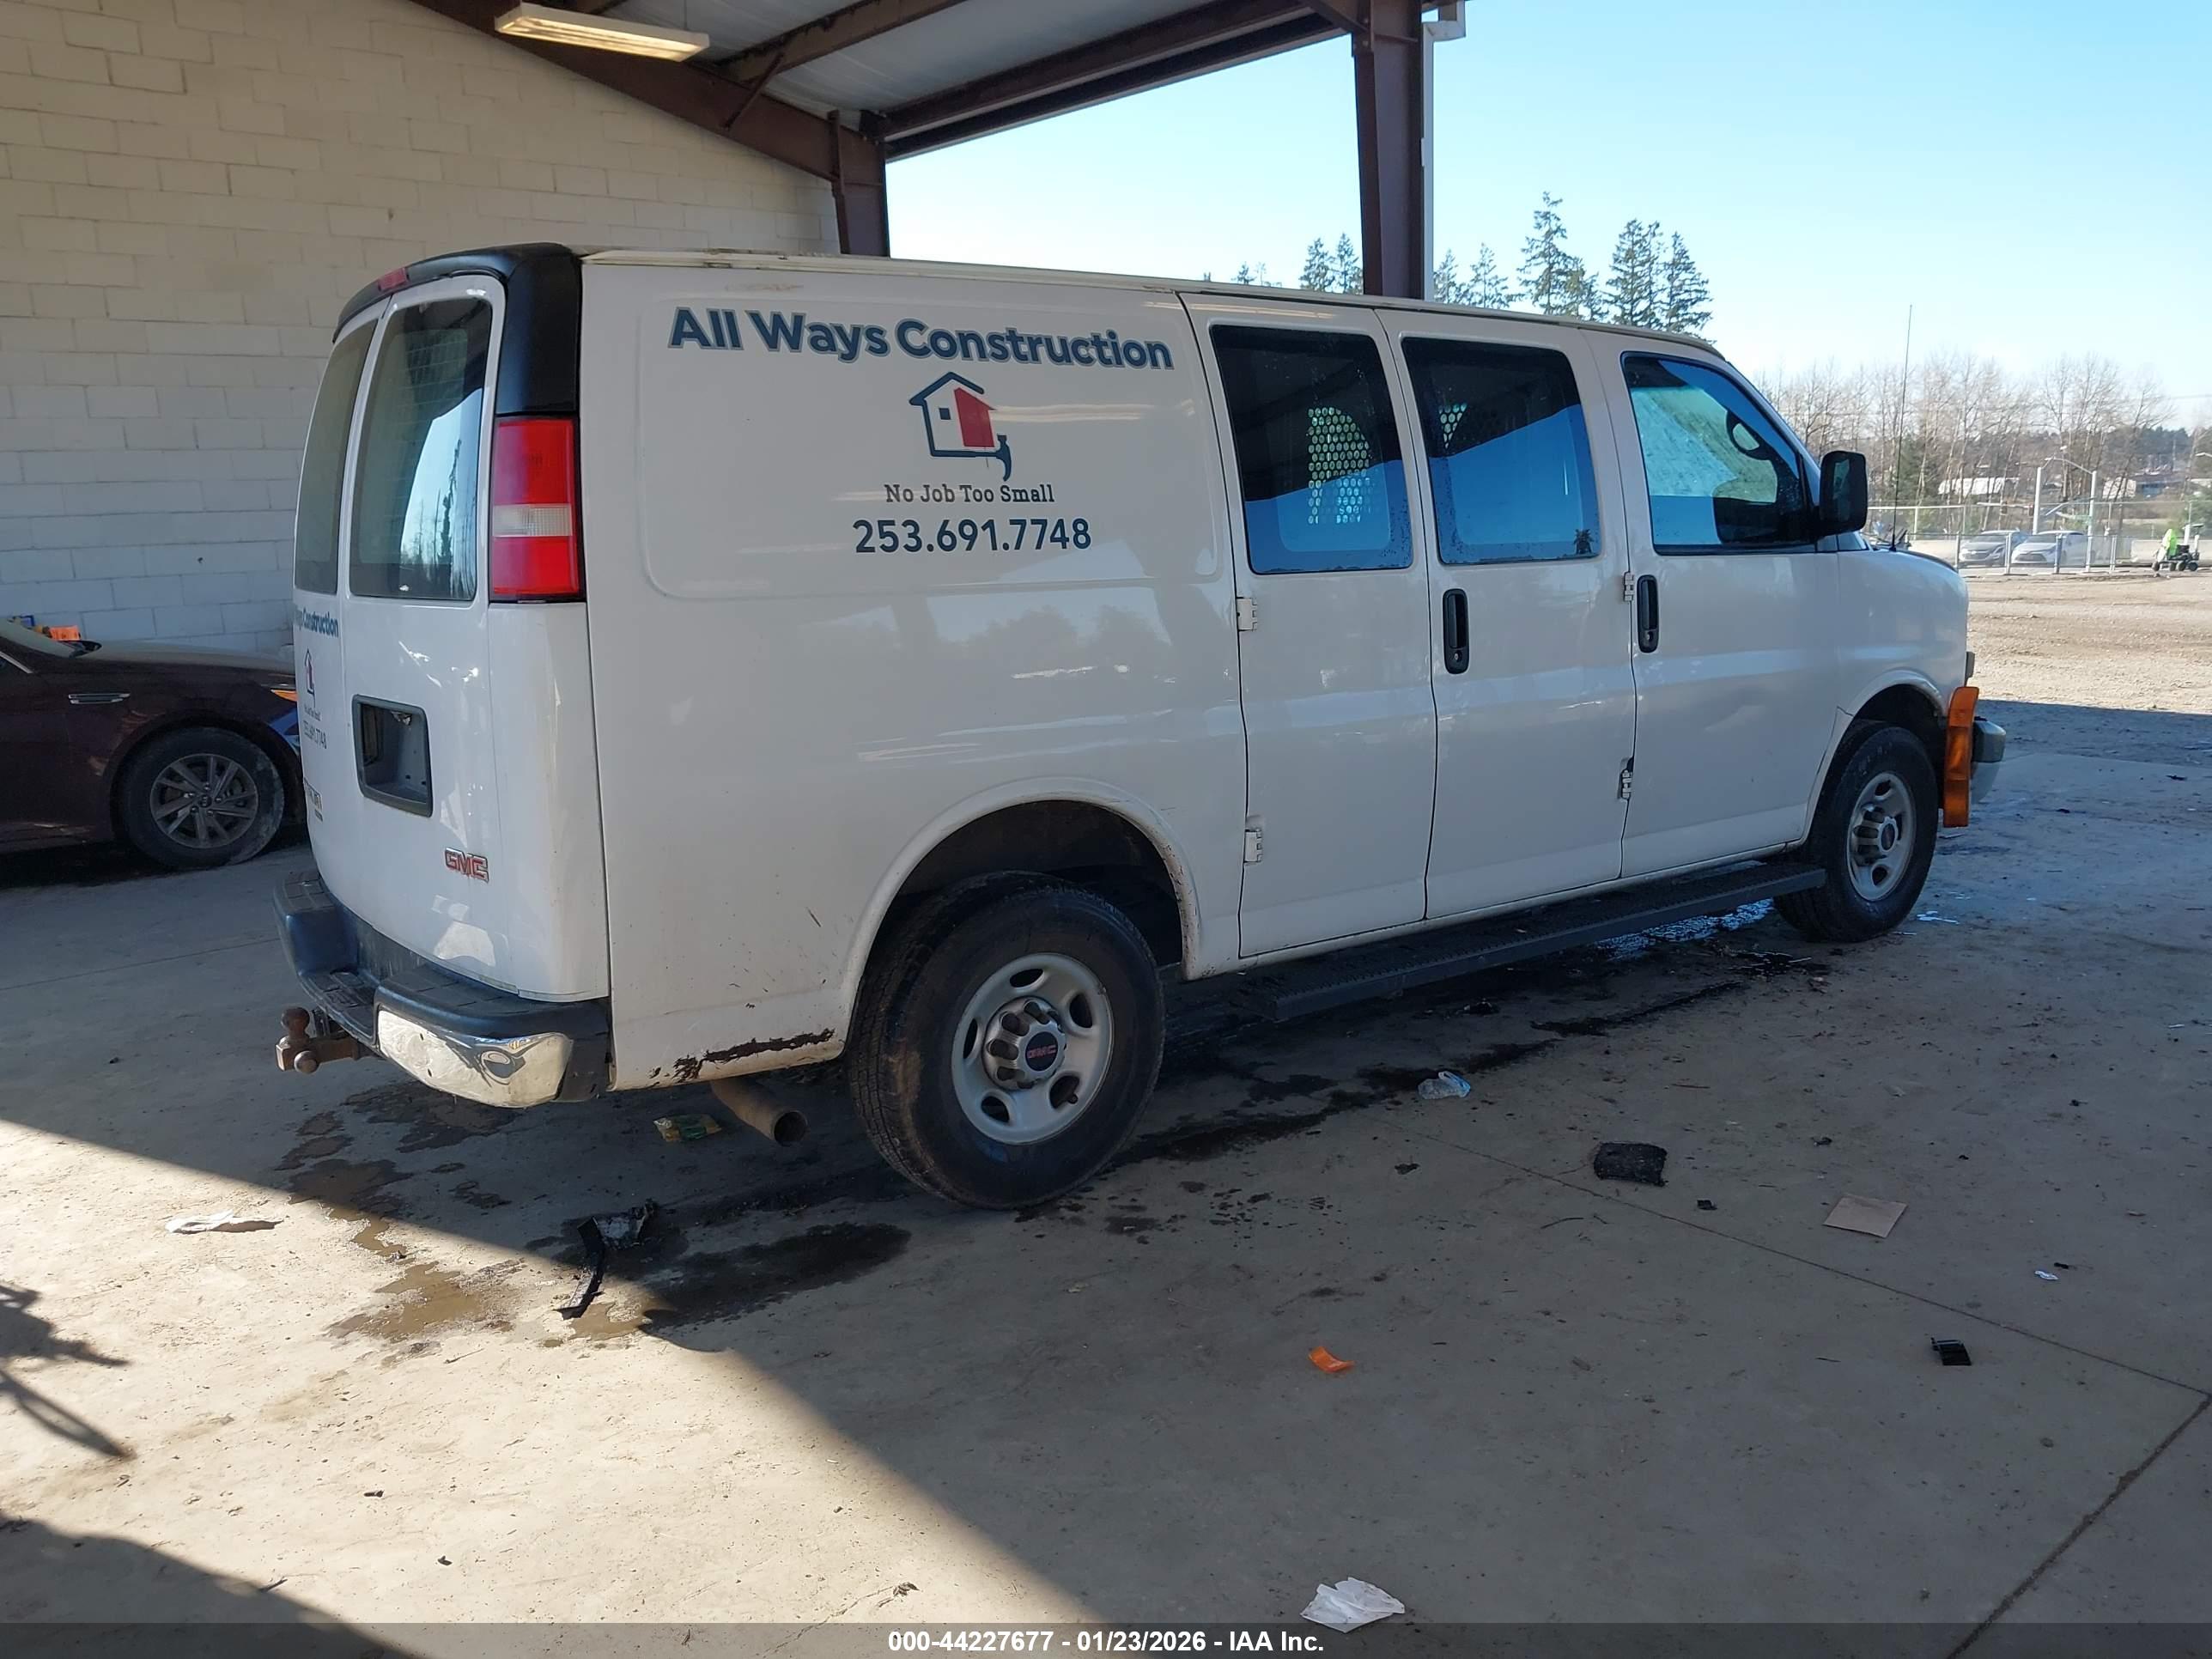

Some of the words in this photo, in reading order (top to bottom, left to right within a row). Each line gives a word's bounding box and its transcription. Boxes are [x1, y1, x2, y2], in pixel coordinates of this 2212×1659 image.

[667, 307, 744, 350] All
[744, 310, 891, 363] Ways
[895, 319, 1174, 370] Construction
[884, 483, 914, 503] No
[920, 483, 955, 503] Job
[959, 484, 994, 503] Too
[1000, 483, 1055, 503] Small
[853, 518, 1091, 553] 253.691.7748
[445, 847, 489, 884] GMC
